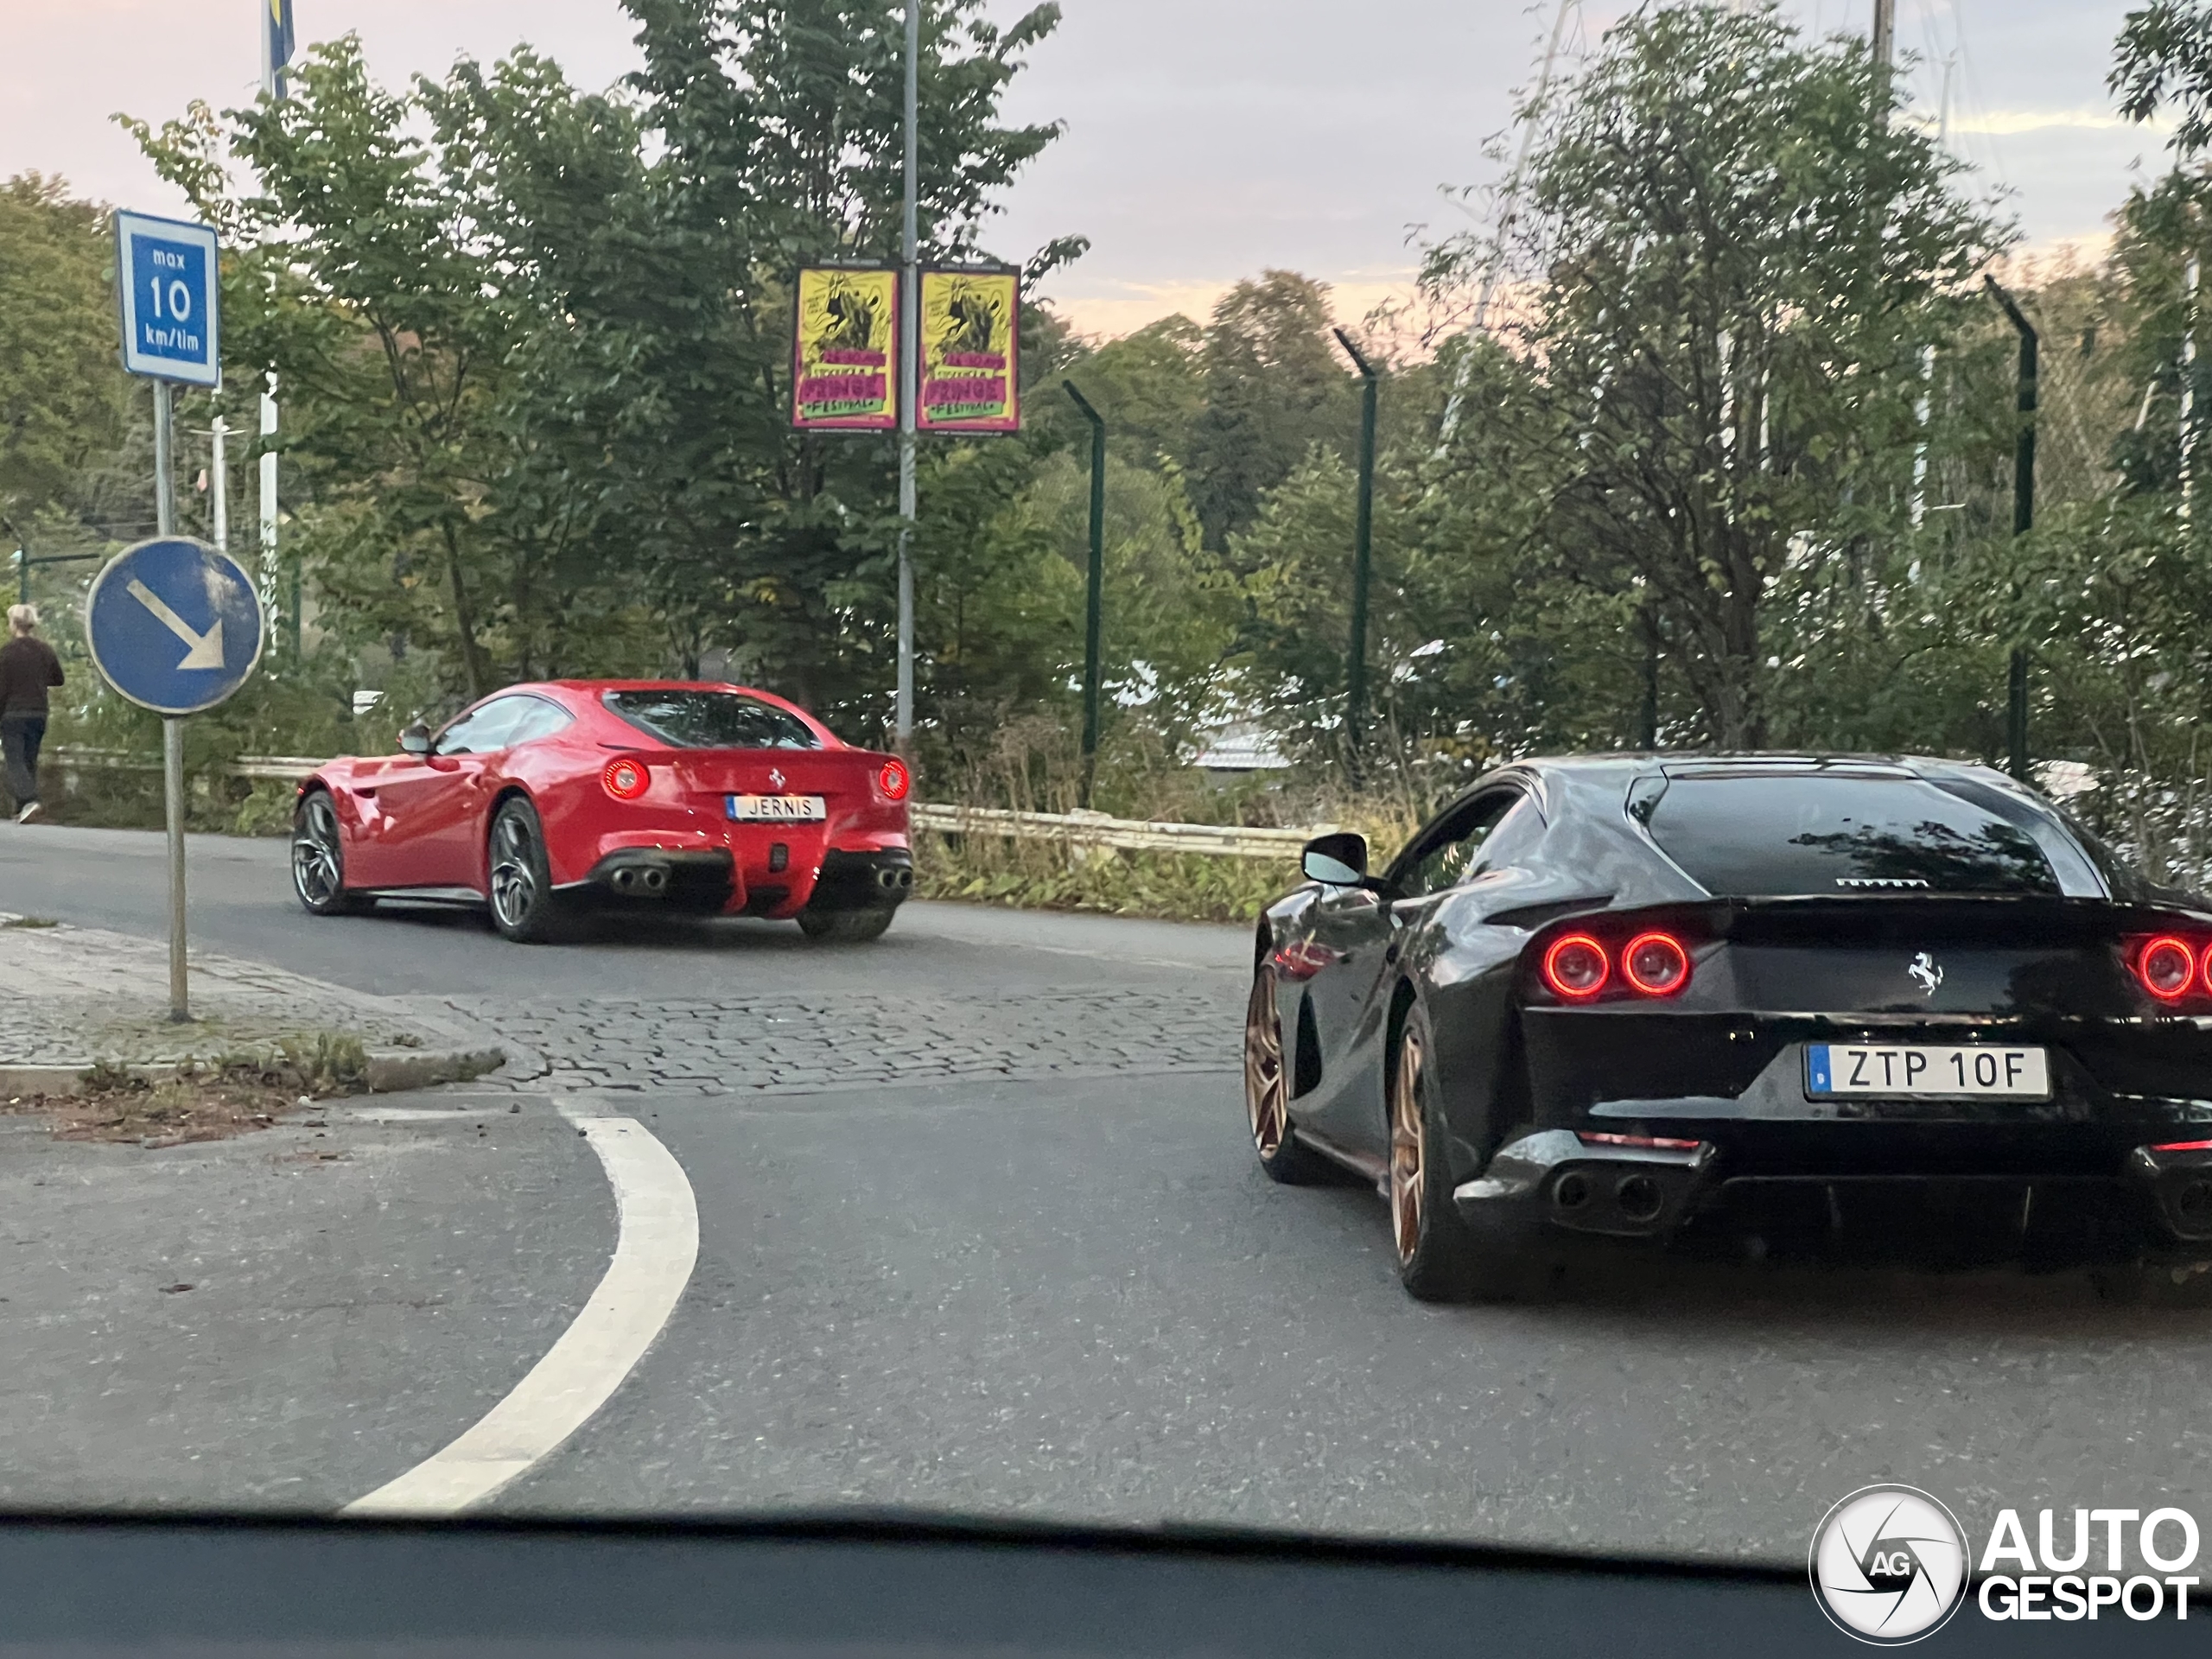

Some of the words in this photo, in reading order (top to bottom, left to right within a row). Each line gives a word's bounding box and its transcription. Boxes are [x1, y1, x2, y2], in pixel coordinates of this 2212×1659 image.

[153, 249, 185, 270] max
[150, 276, 191, 322] 10
[145, 322, 199, 351] km/tim
[749, 798, 812, 816] JERNIS
[1848, 1051, 1927, 1087] ZTP
[1950, 1052, 2024, 1088] 10F
